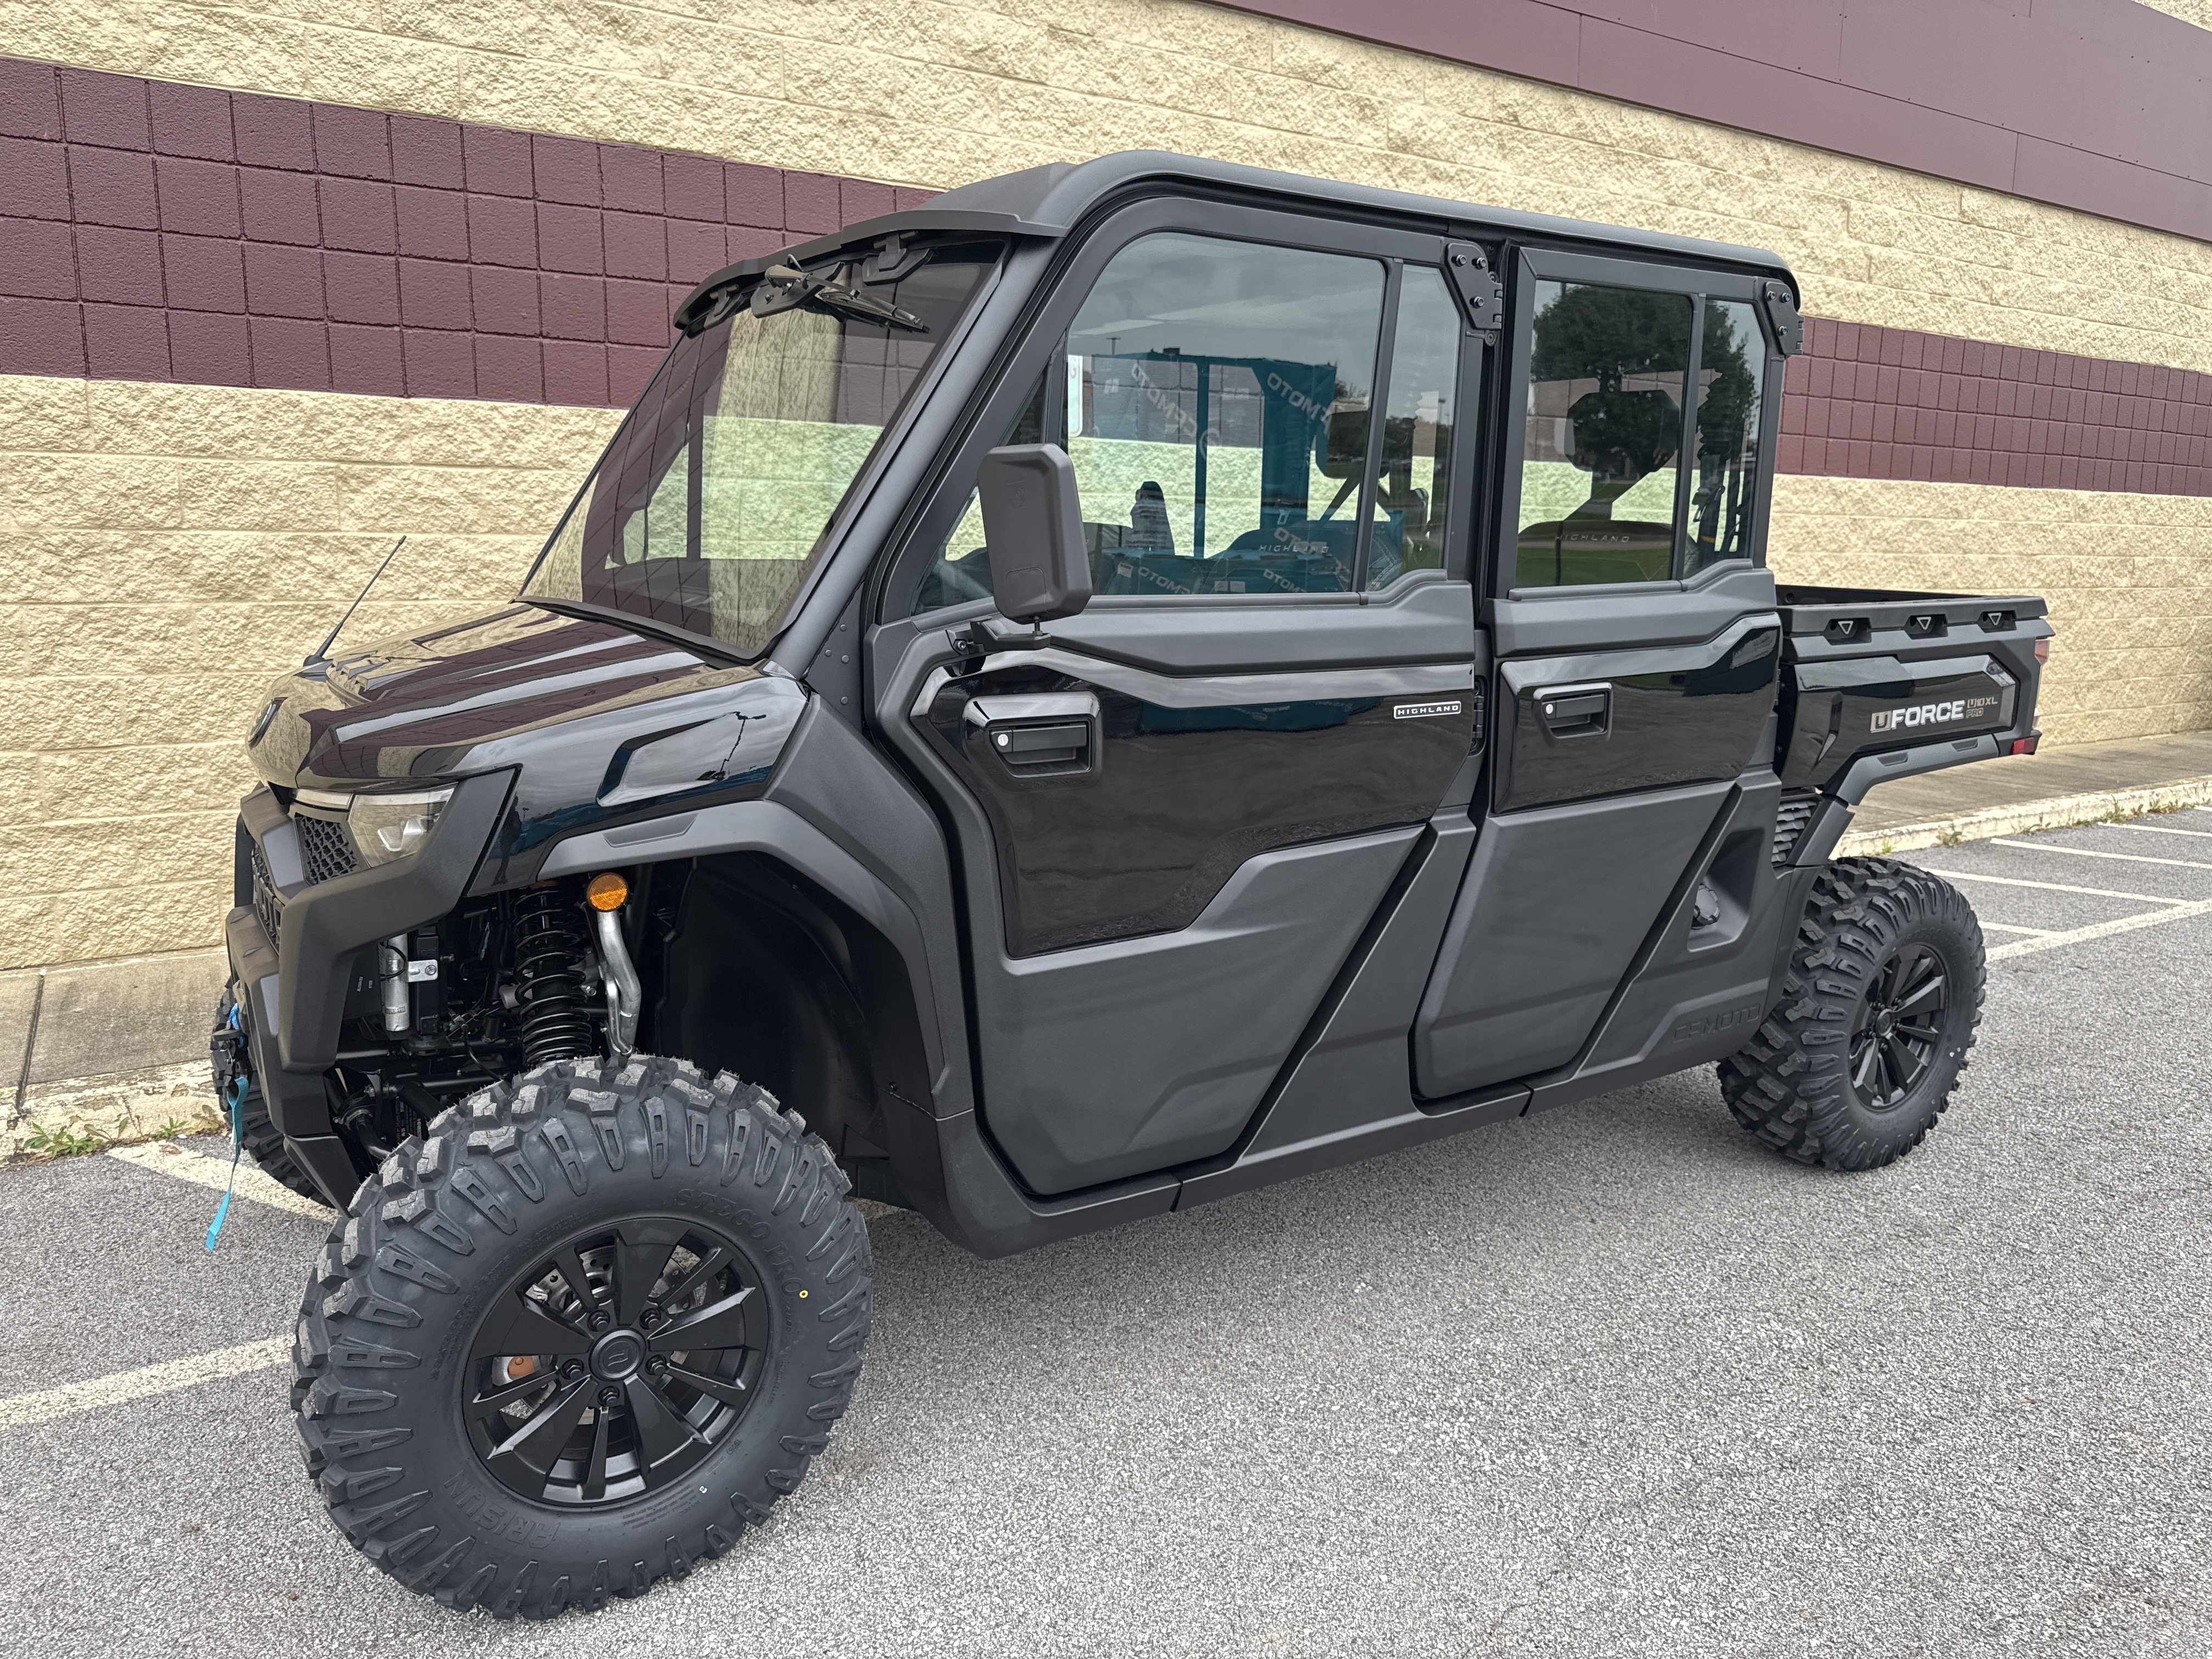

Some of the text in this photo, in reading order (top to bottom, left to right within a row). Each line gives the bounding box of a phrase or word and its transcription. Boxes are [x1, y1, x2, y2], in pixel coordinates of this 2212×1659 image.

[1397, 705, 1459, 715] HIGHLAND
[1966, 707, 1984, 719] PRO
[1673, 1003, 1761, 1043] CFMOTO
[763, 1239, 804, 1296] PRO
[443, 1469, 561, 1549] ARISUN
